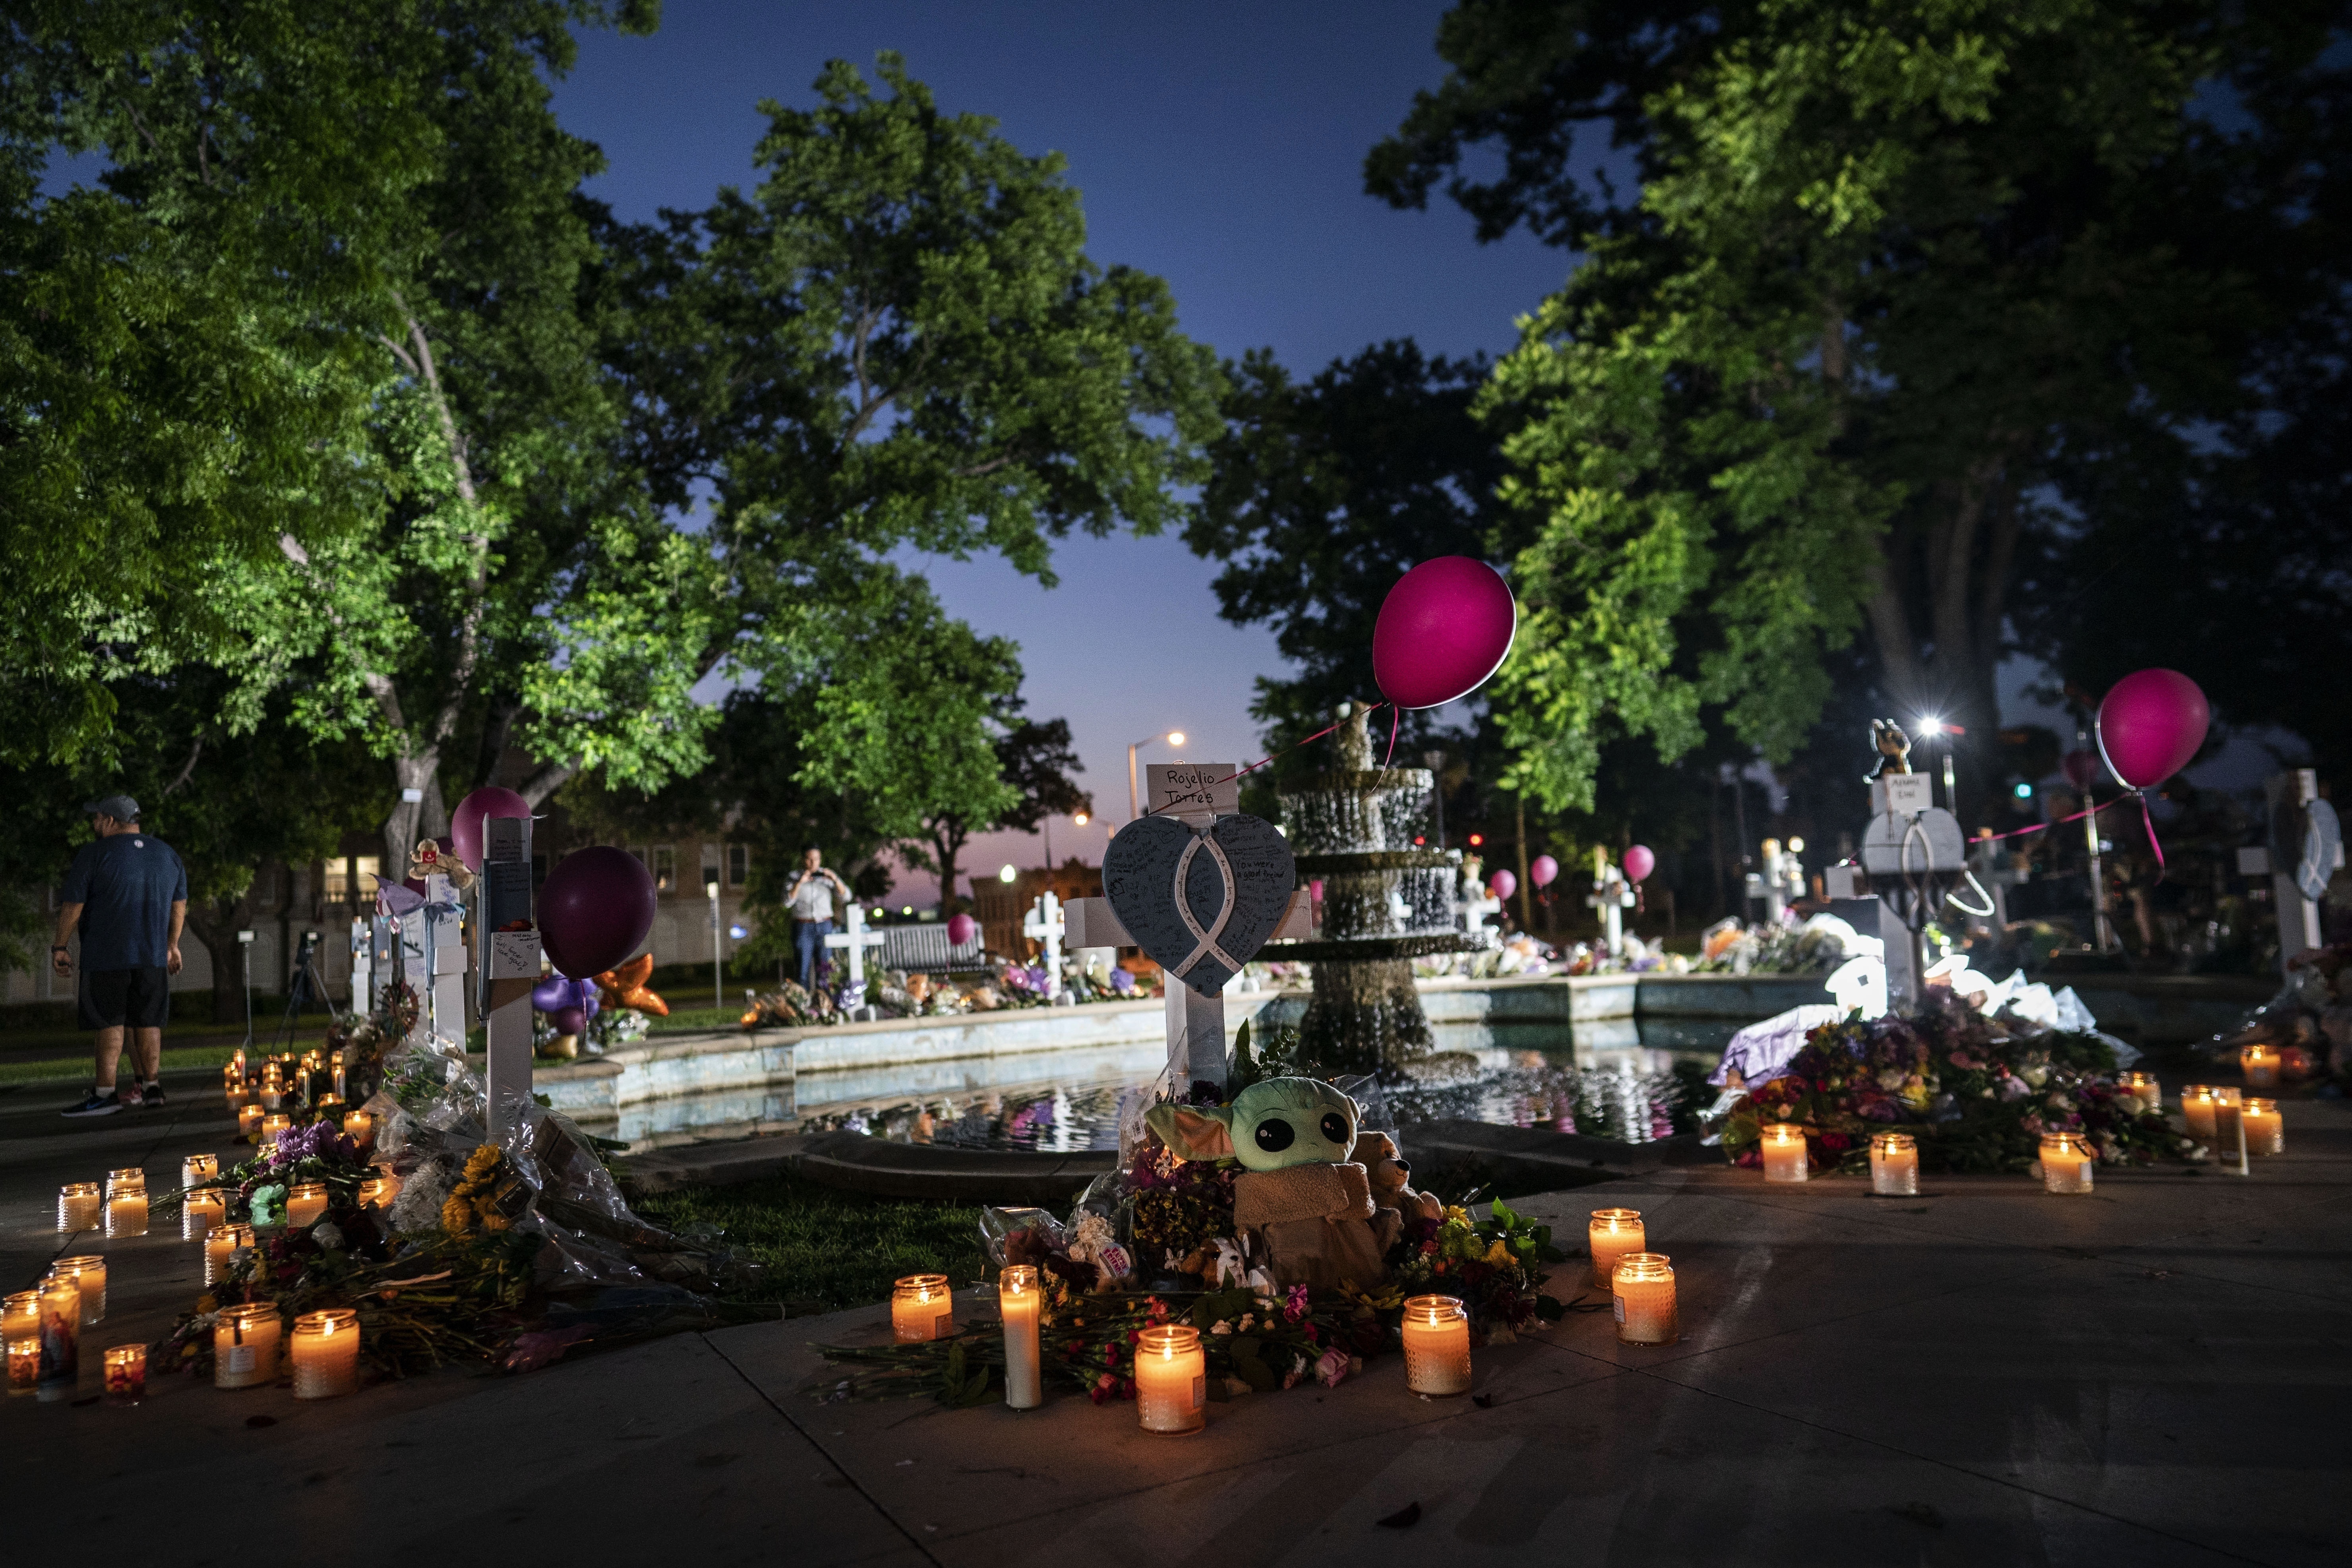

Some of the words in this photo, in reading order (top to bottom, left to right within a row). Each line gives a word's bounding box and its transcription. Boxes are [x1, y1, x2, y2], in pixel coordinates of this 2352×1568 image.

[1167, 770, 1214, 788] Rojelio
[1164, 790, 1214, 803] Torres
[1235, 859, 1252, 869] You
[1253, 860, 1274, 869] were
[1244, 869, 1260, 881] good
[1111, 1247, 1128, 1270] FUZZY
